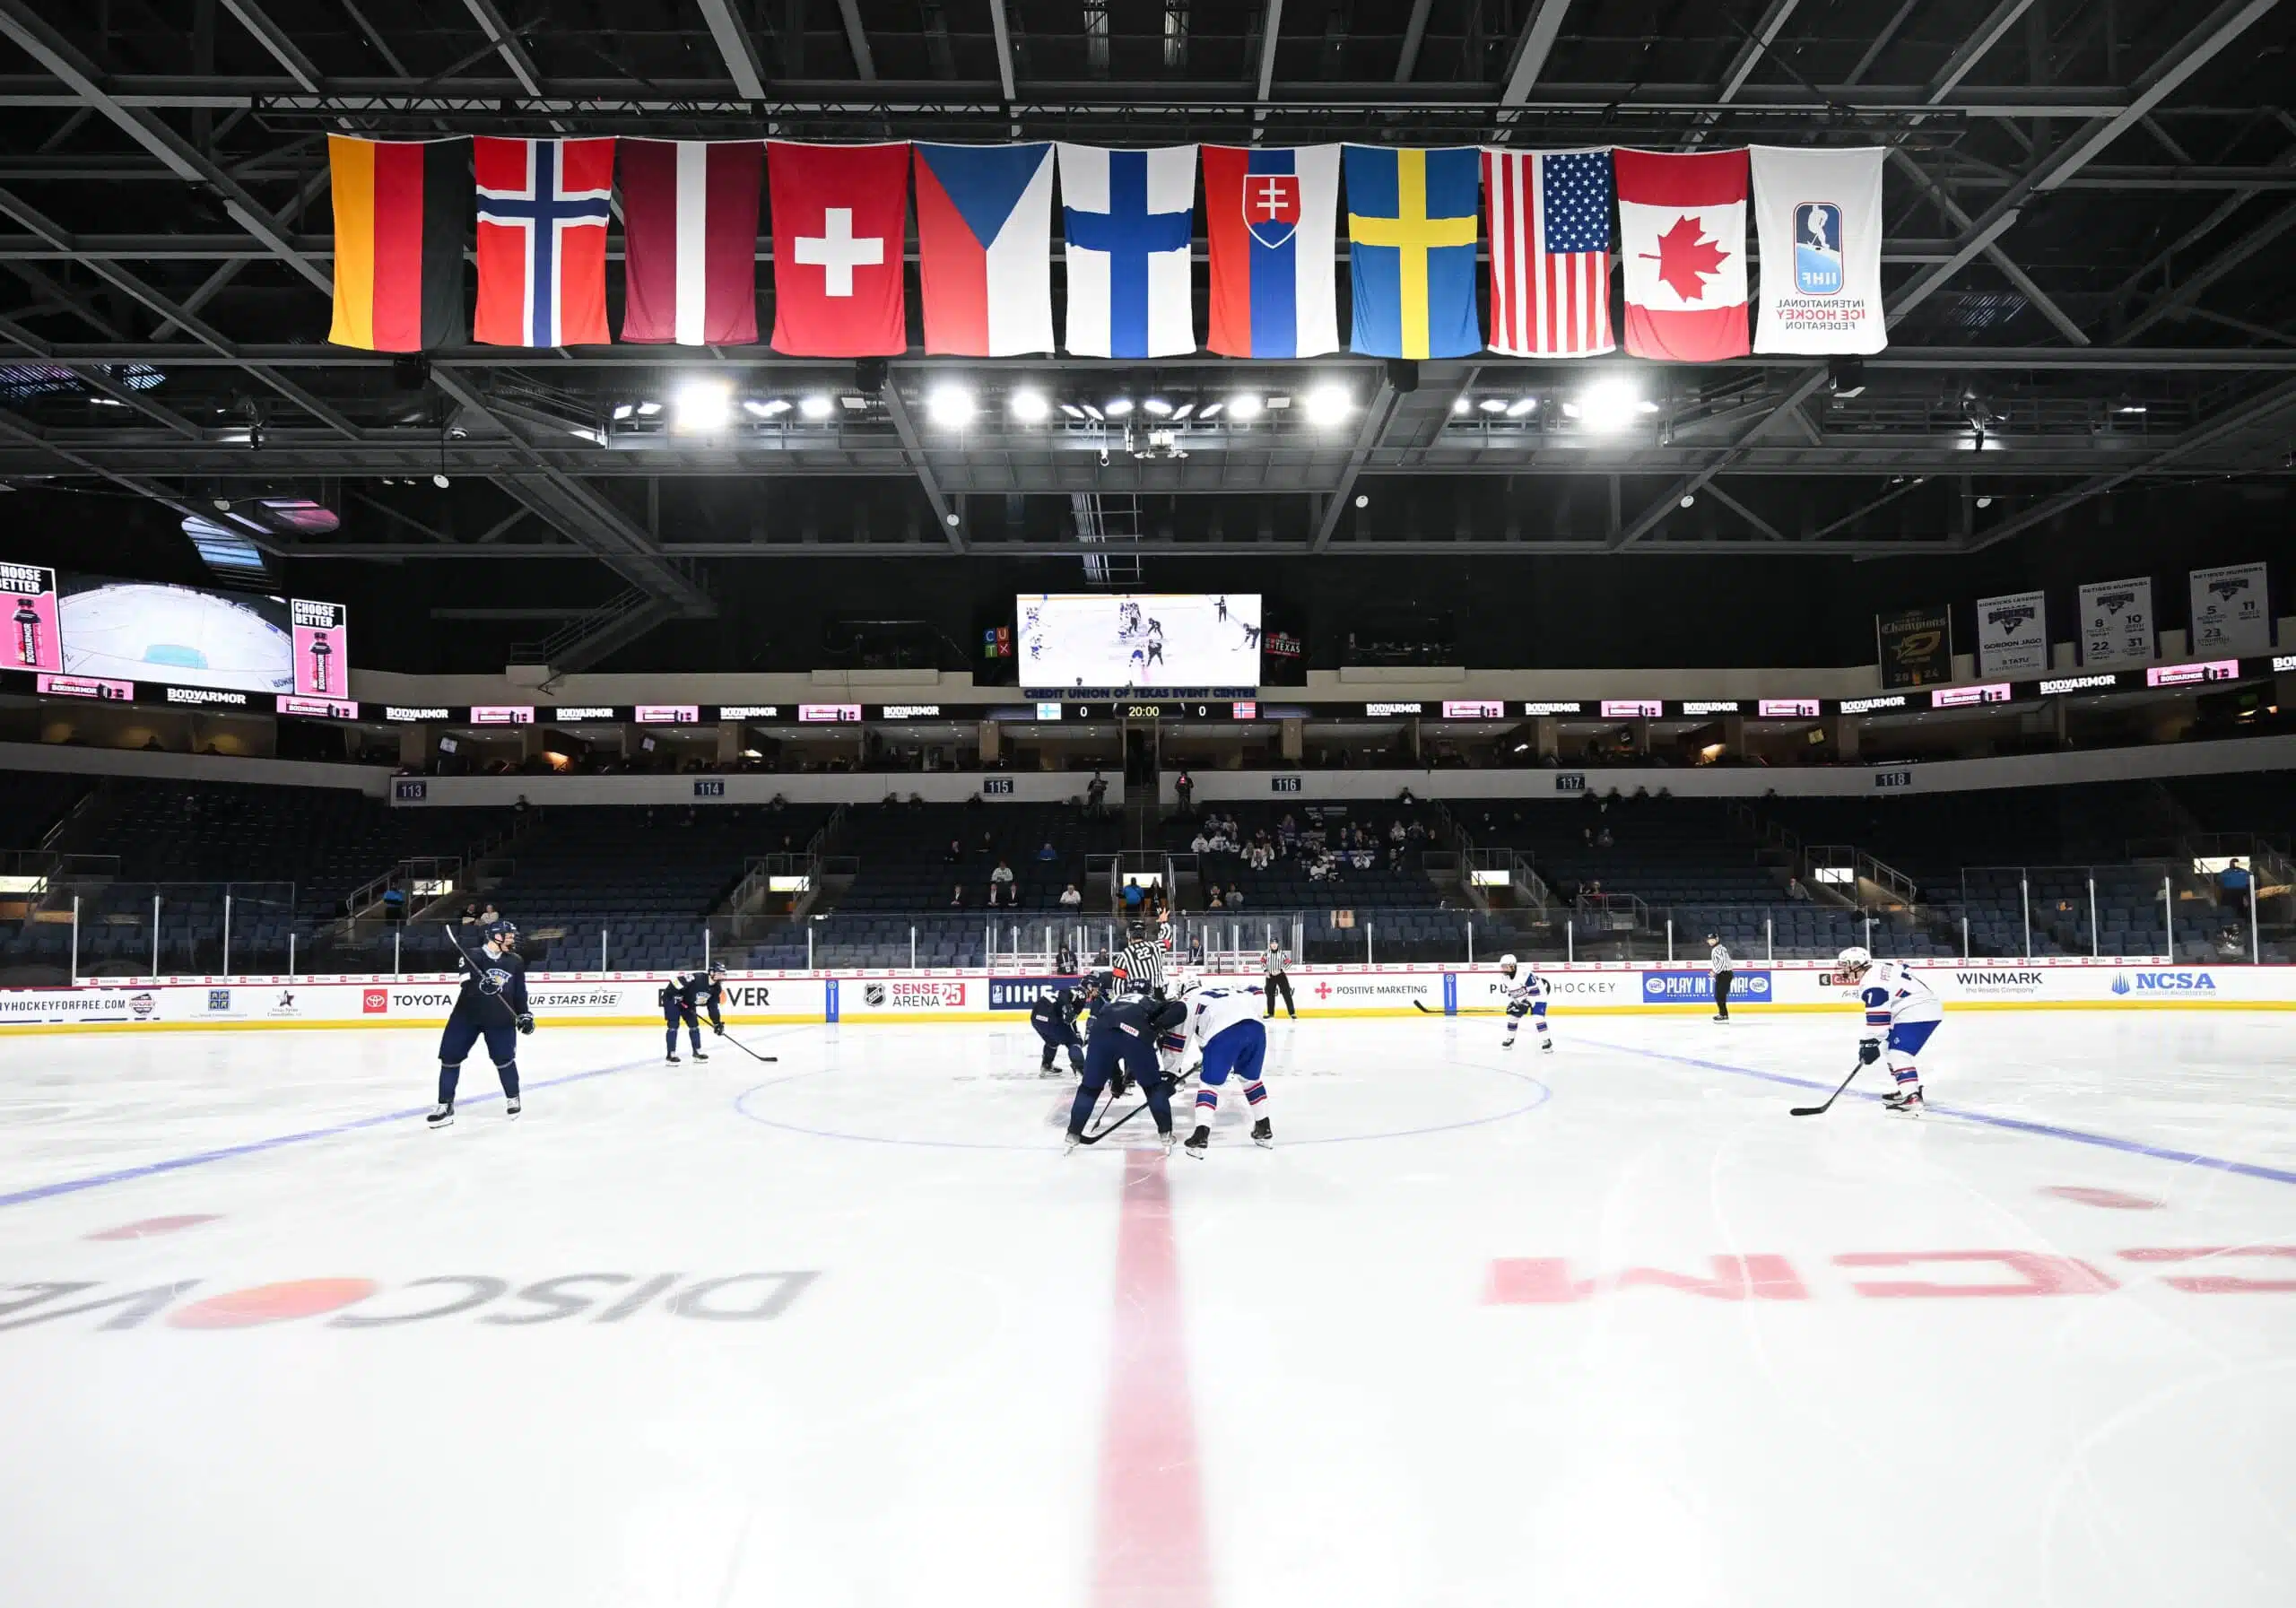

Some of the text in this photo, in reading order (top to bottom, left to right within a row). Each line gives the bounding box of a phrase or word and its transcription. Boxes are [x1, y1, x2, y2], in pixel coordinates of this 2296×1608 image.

[294, 602, 335, 617] CHOOSE
[295, 613, 333, 628] BETTER
[2095, 618, 2104, 628] 8
[2126, 614, 2142, 623] 10
[2092, 641, 2109, 651] 22
[2128, 638, 2143, 647] 31
[2039, 674, 2117, 692] BODYARMOR
[167, 688, 247, 704] BODYARMOR
[1023, 688, 1257, 699] CREDIT UNION OF TEXAS EVENT CENTER
[1366, 703, 1422, 713] BODYARMOR
[1526, 703, 1580, 713] BODYARMOR
[1683, 702, 1738, 711] BODYARMOR
[1839, 697, 1906, 710] BODYARMOR
[386, 707, 448, 718] BODYARMOR
[556, 708, 613, 717] BODYARMOR
[720, 707, 777, 717] BODYARMOR
[883, 706, 939, 716] BODYARMOR
[1080, 707, 1088, 717] 0
[1129, 707, 1160, 717] 20:00
[1198, 706, 1206, 717] 0
[1277, 778, 1297, 791] 116
[1561, 778, 1580, 789] 117
[1882, 774, 1905, 787] 118
[402, 785, 422, 797] 113
[700, 783, 719, 795] 114
[989, 781, 1009, 793] 115
[1136, 947, 1152, 959] 22
[1956, 972, 2043, 985] WINMARK
[2135, 973, 2216, 989] NCSA
[892, 983, 939, 995] SENSE
[1336, 985, 1428, 995] POSITIVE MARKETING
[1553, 982, 1615, 994] HOCKEY
[1666, 978, 1692, 993] PLAY
[1695, 978, 1704, 993] IN
[393, 995, 452, 1006] TOYOTA
[548, 995, 586, 1005] STARS
[588, 995, 617, 1004] RISE
[892, 995, 941, 1007] ARENA
